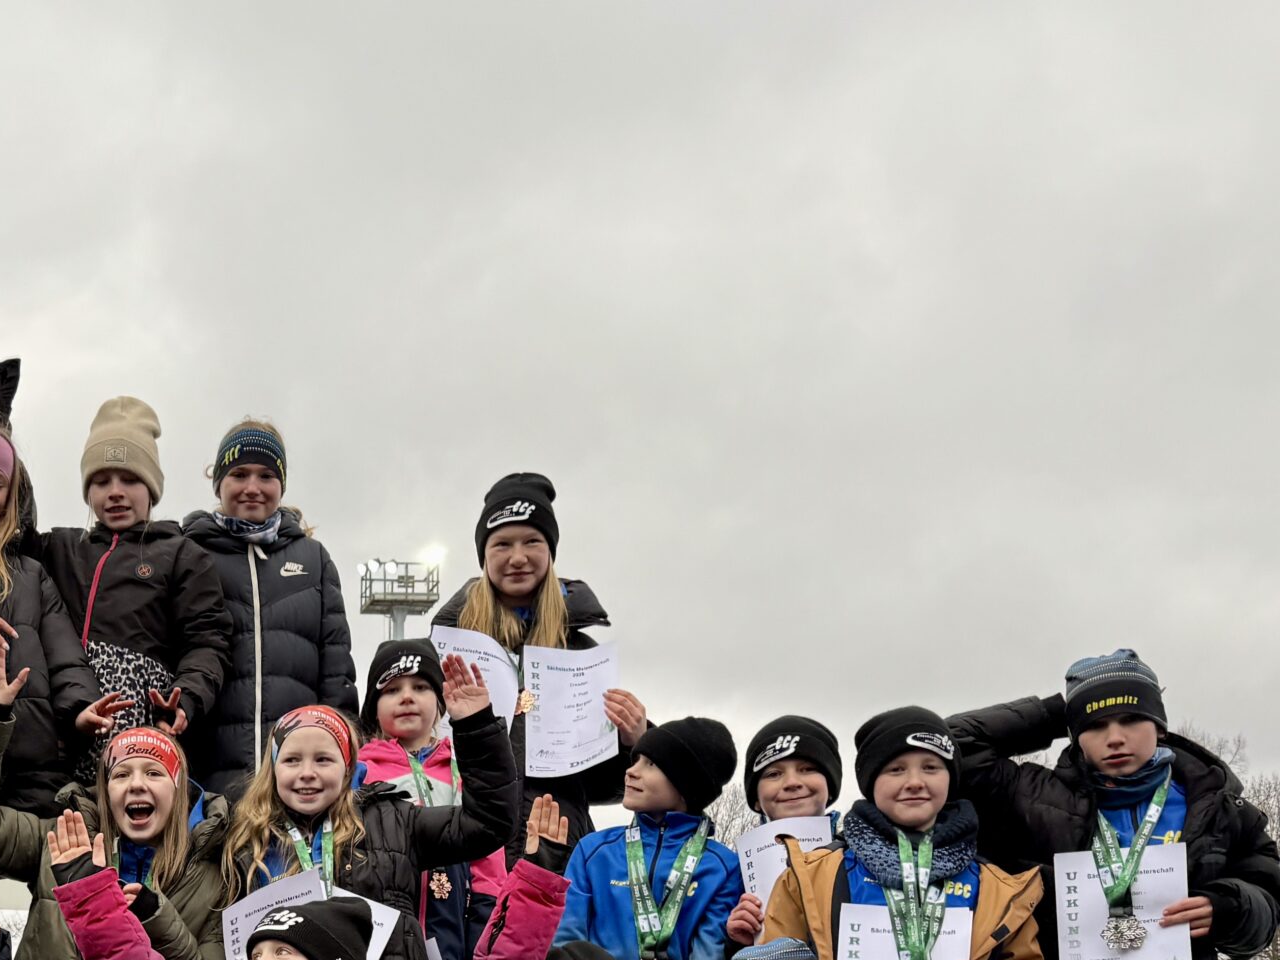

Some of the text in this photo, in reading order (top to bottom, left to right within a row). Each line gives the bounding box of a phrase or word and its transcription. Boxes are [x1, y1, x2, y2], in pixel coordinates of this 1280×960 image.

[284, 561, 304, 572] NIKE
[1086, 695, 1138, 714] Chemnitz
[125, 743, 165, 762] Berlin
[745, 848, 757, 894] URKU
